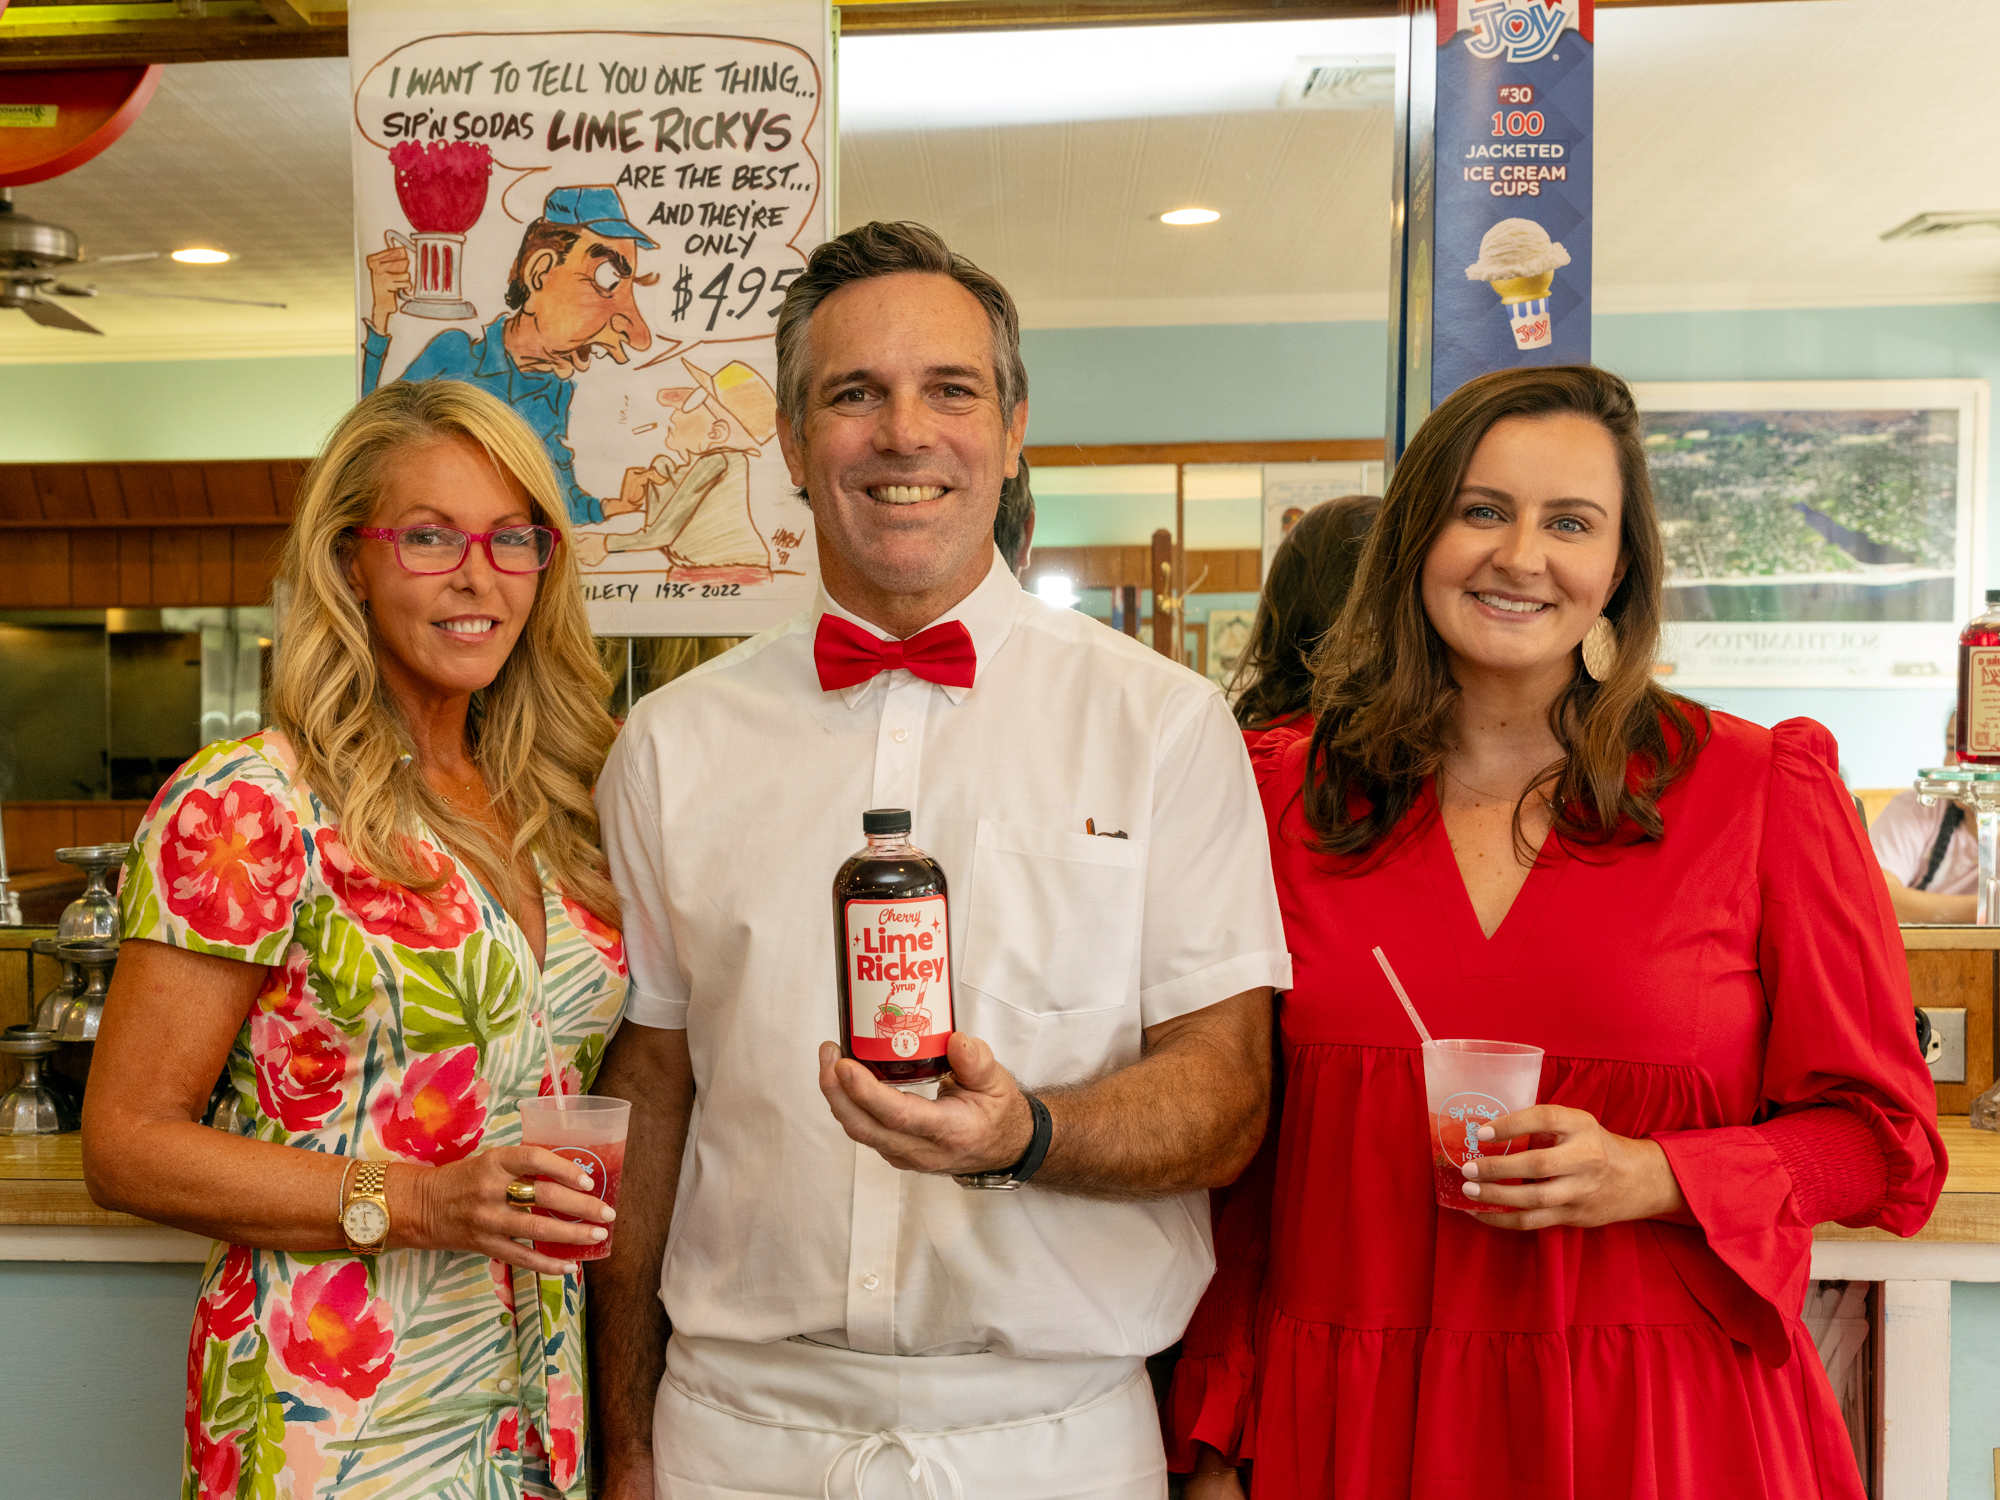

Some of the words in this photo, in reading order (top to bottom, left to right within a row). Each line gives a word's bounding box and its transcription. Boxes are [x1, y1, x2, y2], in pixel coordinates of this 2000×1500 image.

[388, 66, 400, 98] I
[406, 61, 483, 98] WANT
[490, 60, 520, 94] TO
[527, 59, 588, 96] TELL
[599, 61, 647, 94] YOU
[654, 63, 706, 96] ONE
[714, 61, 815, 98] THING...
[1500, 87, 1532, 103] #30
[453, 111, 534, 140] SODAS
[547, 109, 644, 153] LIME
[649, 107, 793, 153] RICKYS
[1492, 111, 1545, 137] 100
[1465, 144, 1564, 158] JACKETED
[616, 163, 667, 190] ARE
[675, 163, 723, 190] THE
[732, 162, 810, 191] BEST...
[1463, 166, 1495, 181] ICE
[1499, 166, 1567, 181] CREAM
[1489, 181, 1541, 196] CUPS
[647, 201, 694, 226] AND
[698, 199, 789, 231] THEY'RE
[684, 230, 757, 260] ONLY
[671, 262, 805, 332] $4.95
[581, 583, 639, 603] ILETY
[701, 583, 741, 598] 2022
[878, 908, 921, 928] Cherry
[863, 927, 933, 953] Lime
[857, 953, 944, 983] Rickey
[891, 982, 916, 993] Syrup
[1475, 1104, 1499, 1121] Sod
